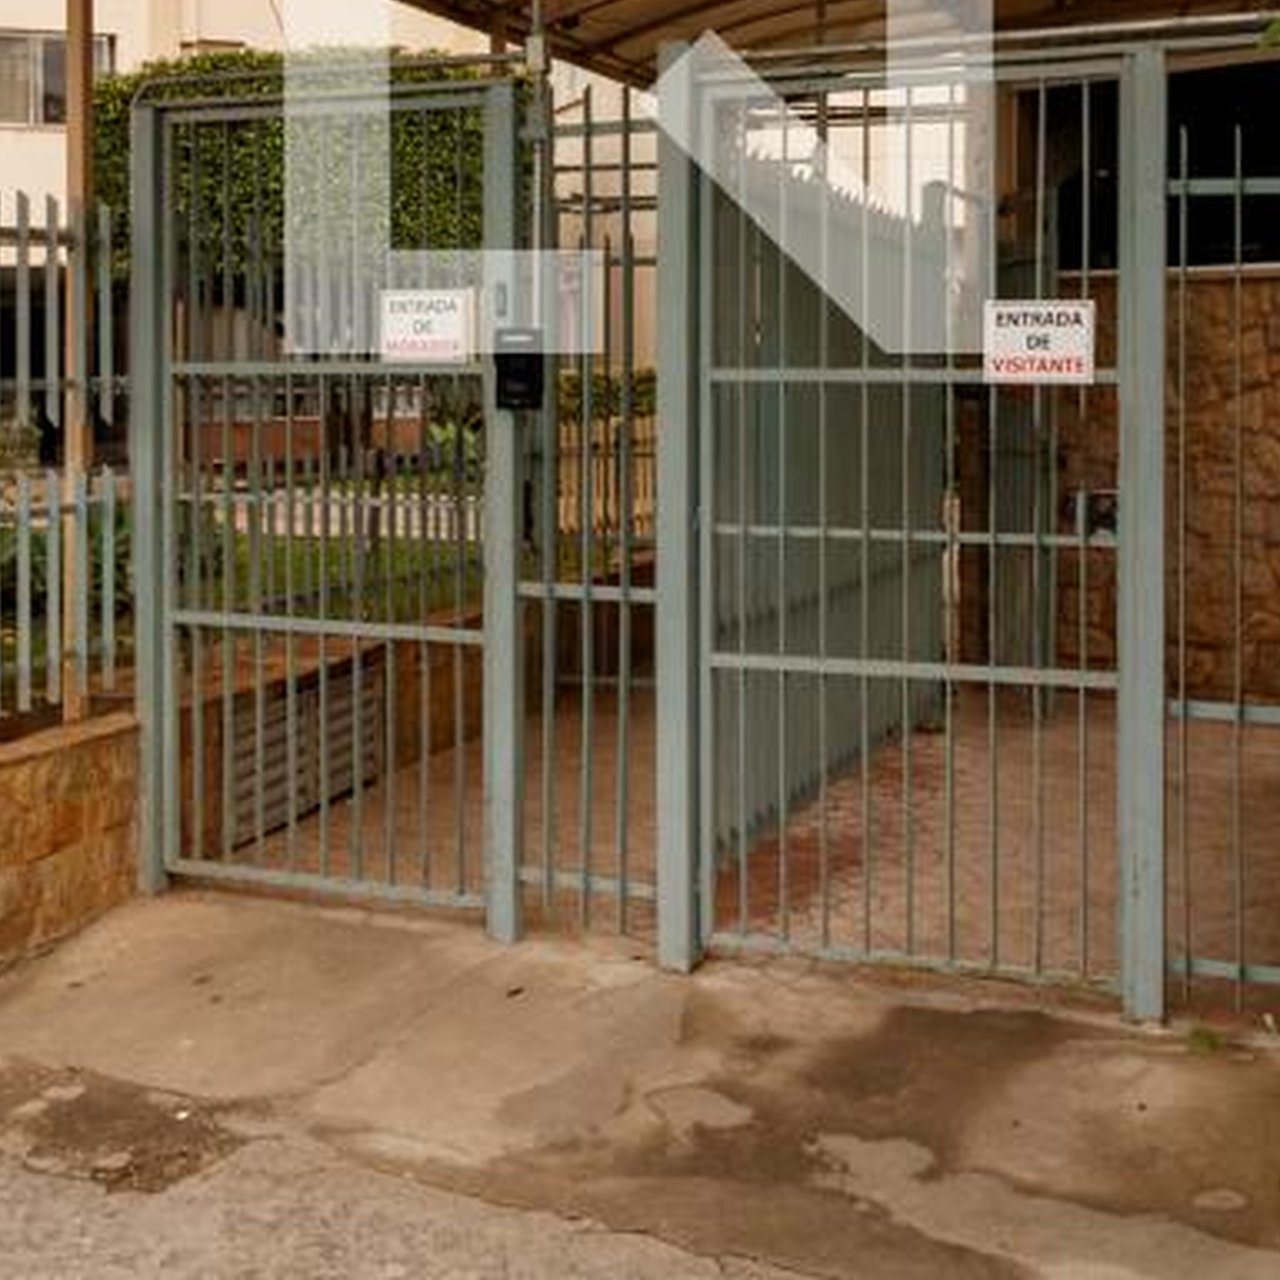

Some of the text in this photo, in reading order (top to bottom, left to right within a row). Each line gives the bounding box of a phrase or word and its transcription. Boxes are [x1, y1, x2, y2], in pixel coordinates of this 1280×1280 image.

[388, 298, 458, 315] ENTRADA
[412, 318, 432, 335] DE
[995, 310, 1084, 328] ENTRADA
[1026, 333, 1051, 351] DE
[992, 356, 1085, 374] VISITANTE
